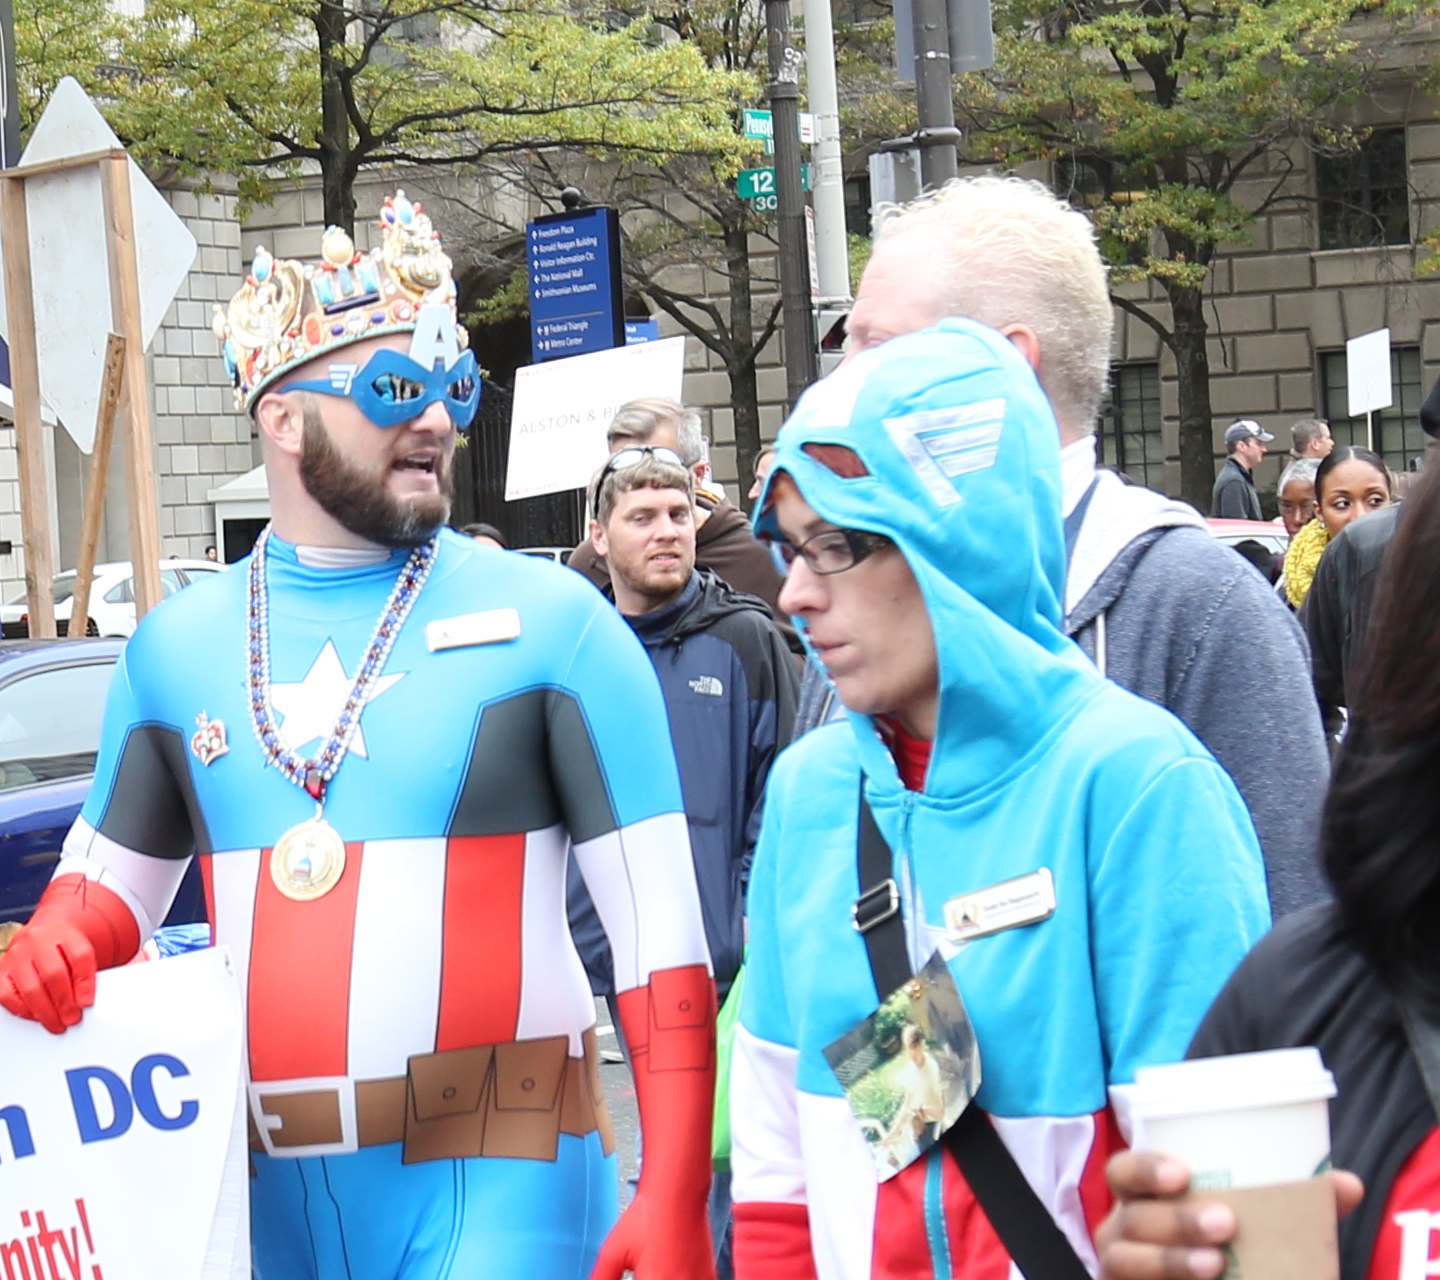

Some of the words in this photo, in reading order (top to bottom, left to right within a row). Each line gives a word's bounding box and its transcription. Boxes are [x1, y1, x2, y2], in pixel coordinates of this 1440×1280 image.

[749, 170, 775, 193] 12
[755, 195, 777, 211] 30
[519, 412, 581, 435] ALSTON
[586, 409, 597, 422] &
[64, 1052, 200, 1146] DC
